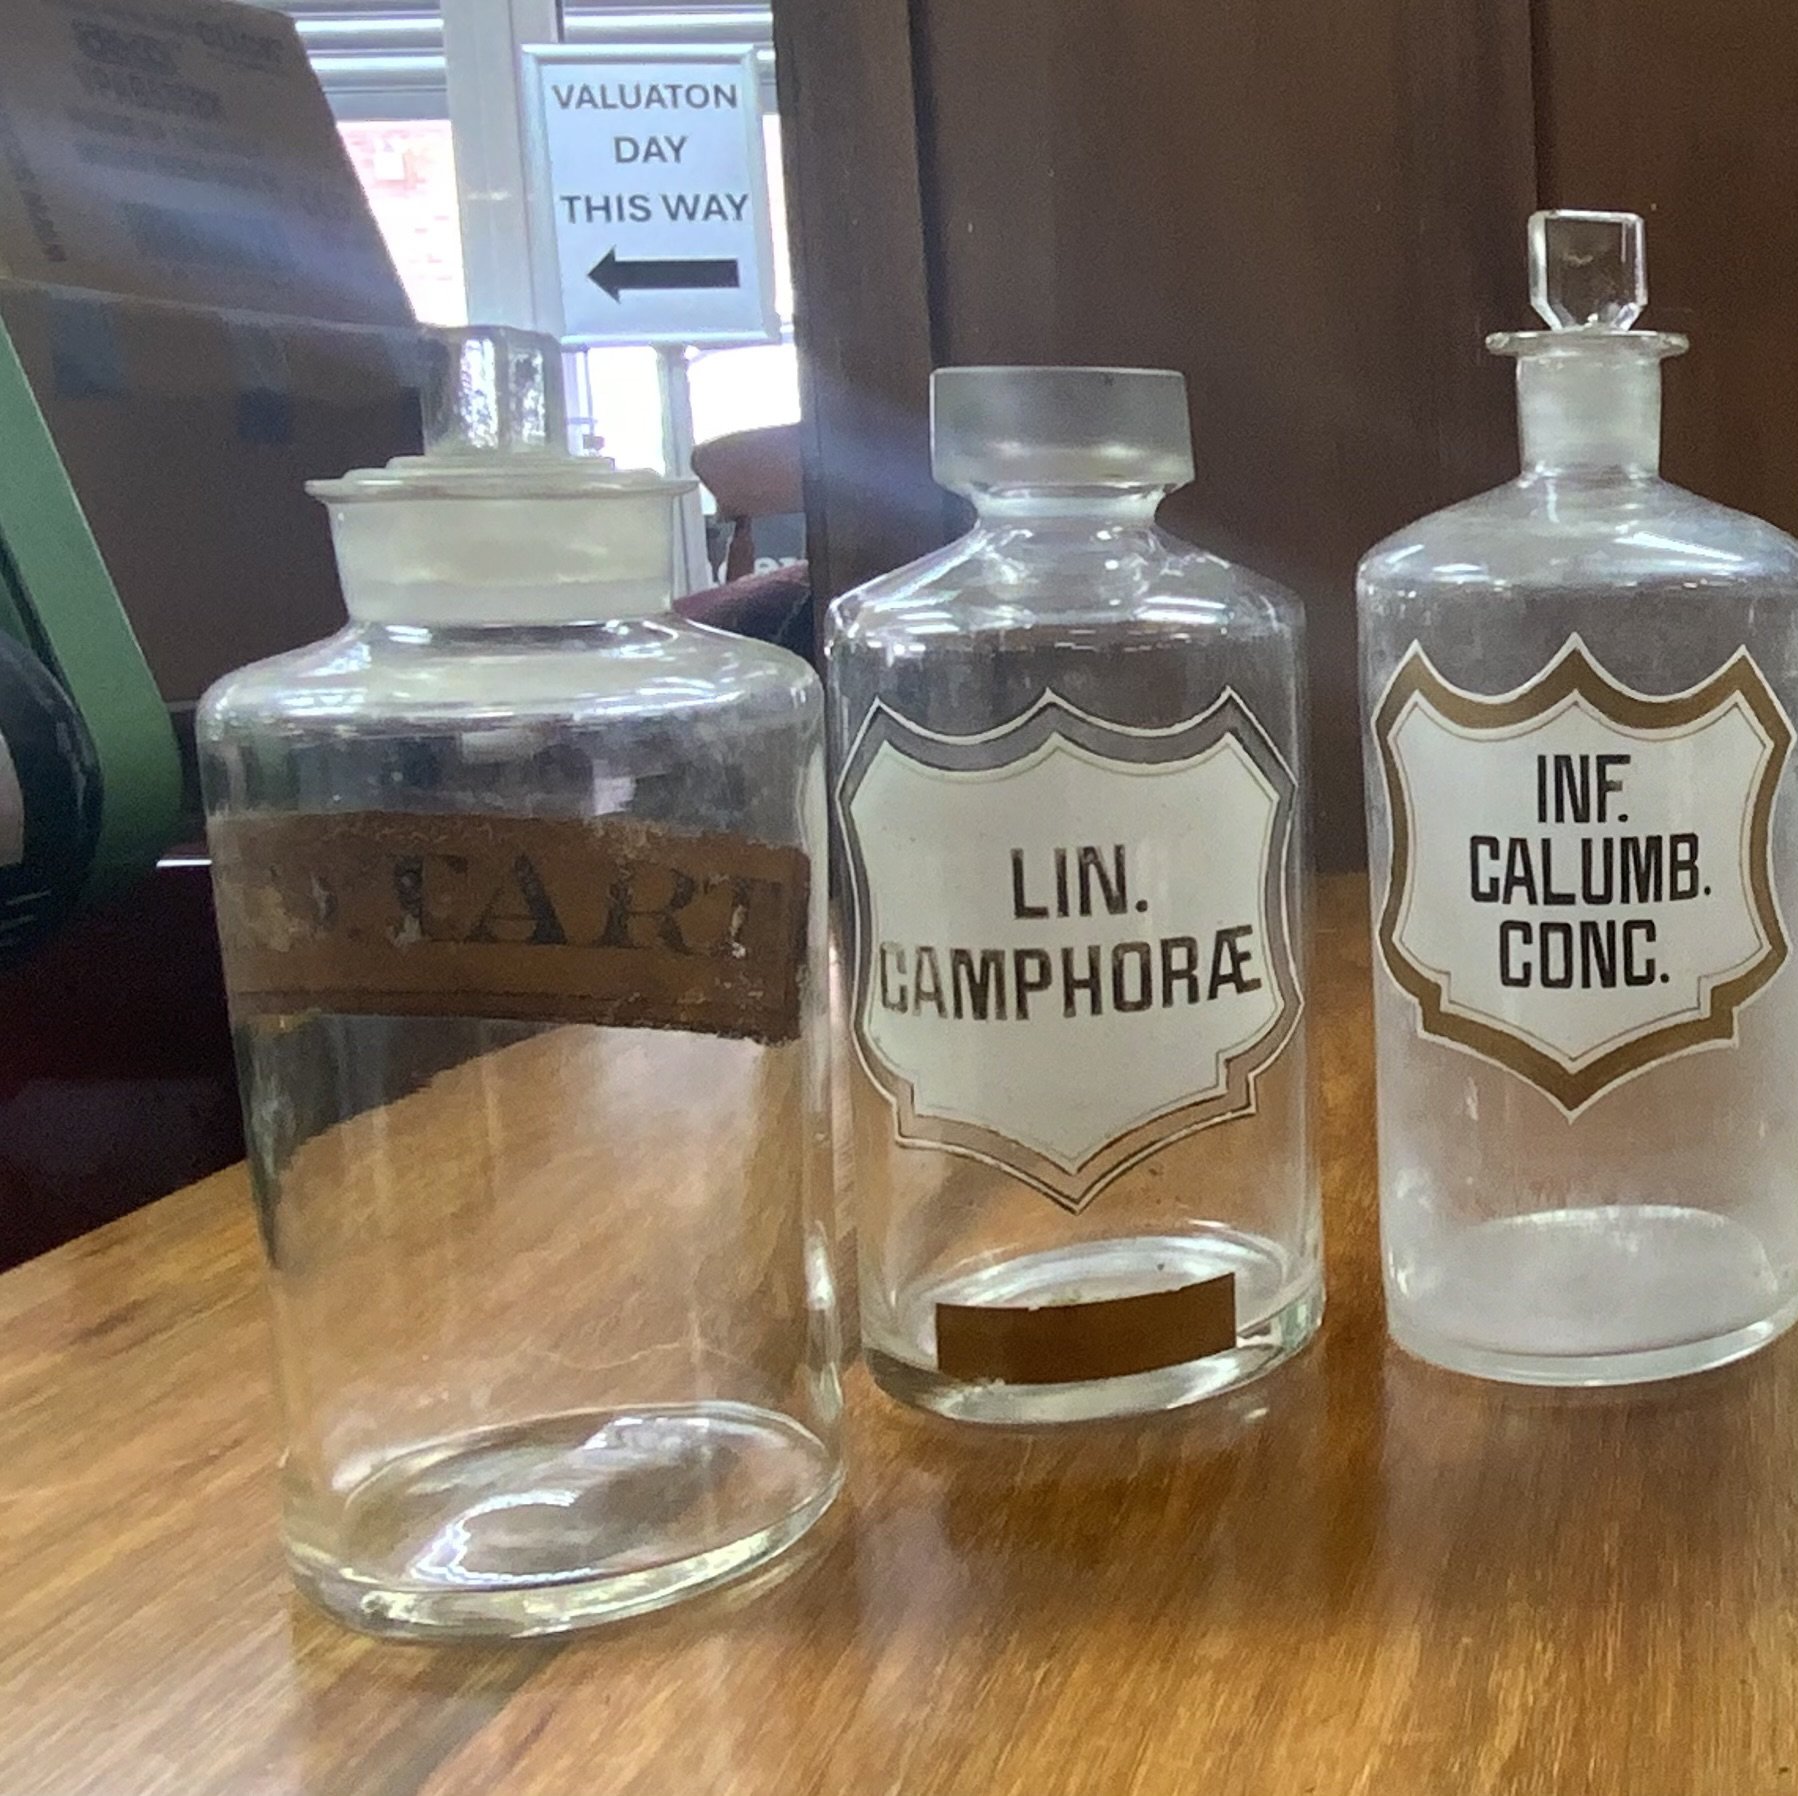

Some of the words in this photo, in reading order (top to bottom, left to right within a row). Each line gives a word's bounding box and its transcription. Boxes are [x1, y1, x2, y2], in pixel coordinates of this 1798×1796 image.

[552, 83, 738, 110] VALUATON
[613, 135, 688, 164] DAY
[560, 194, 653, 224] THIS
[661, 193, 749, 222] WAY
[1536, 754, 1631, 824] INF.
[1010, 843, 1149, 921] LIN.
[1469, 832, 1712, 906] CALUMB.
[878, 923, 1262, 1022] CAMPHORÆ
[1499, 919, 1670, 989] CONC.
